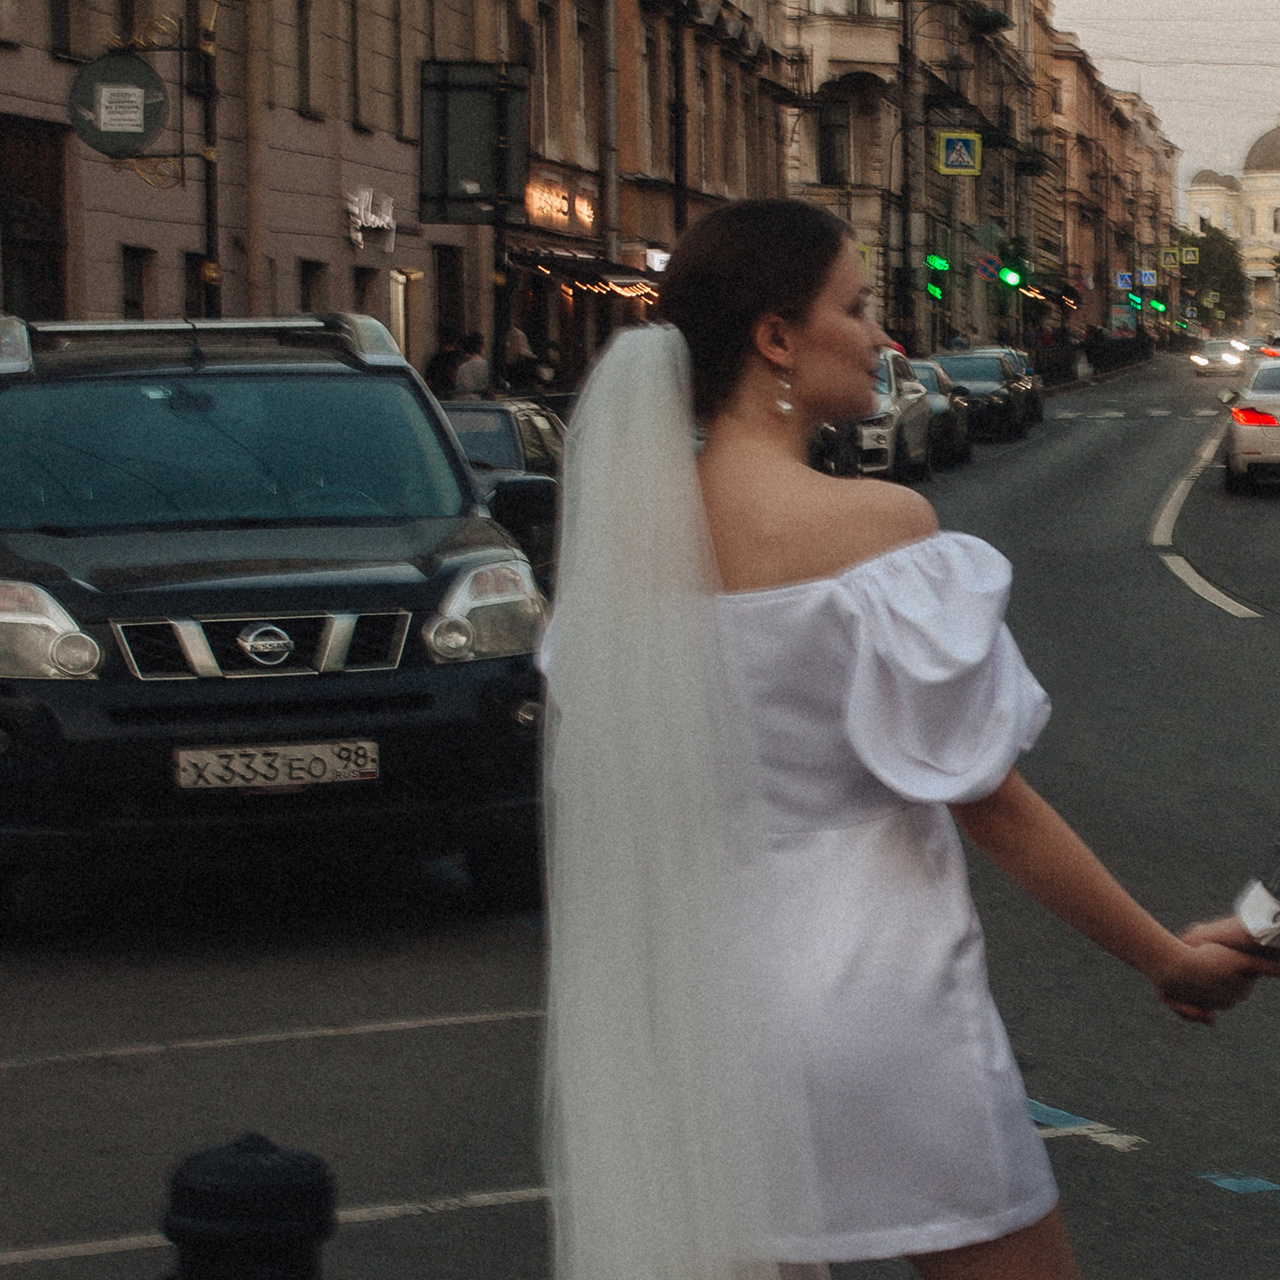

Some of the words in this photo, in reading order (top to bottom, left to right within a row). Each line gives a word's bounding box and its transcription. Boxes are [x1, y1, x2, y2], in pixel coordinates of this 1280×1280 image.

[250, 643, 289, 651] NISSAN
[336, 745, 368, 769] 98
[335, 770, 359, 779] RUS
